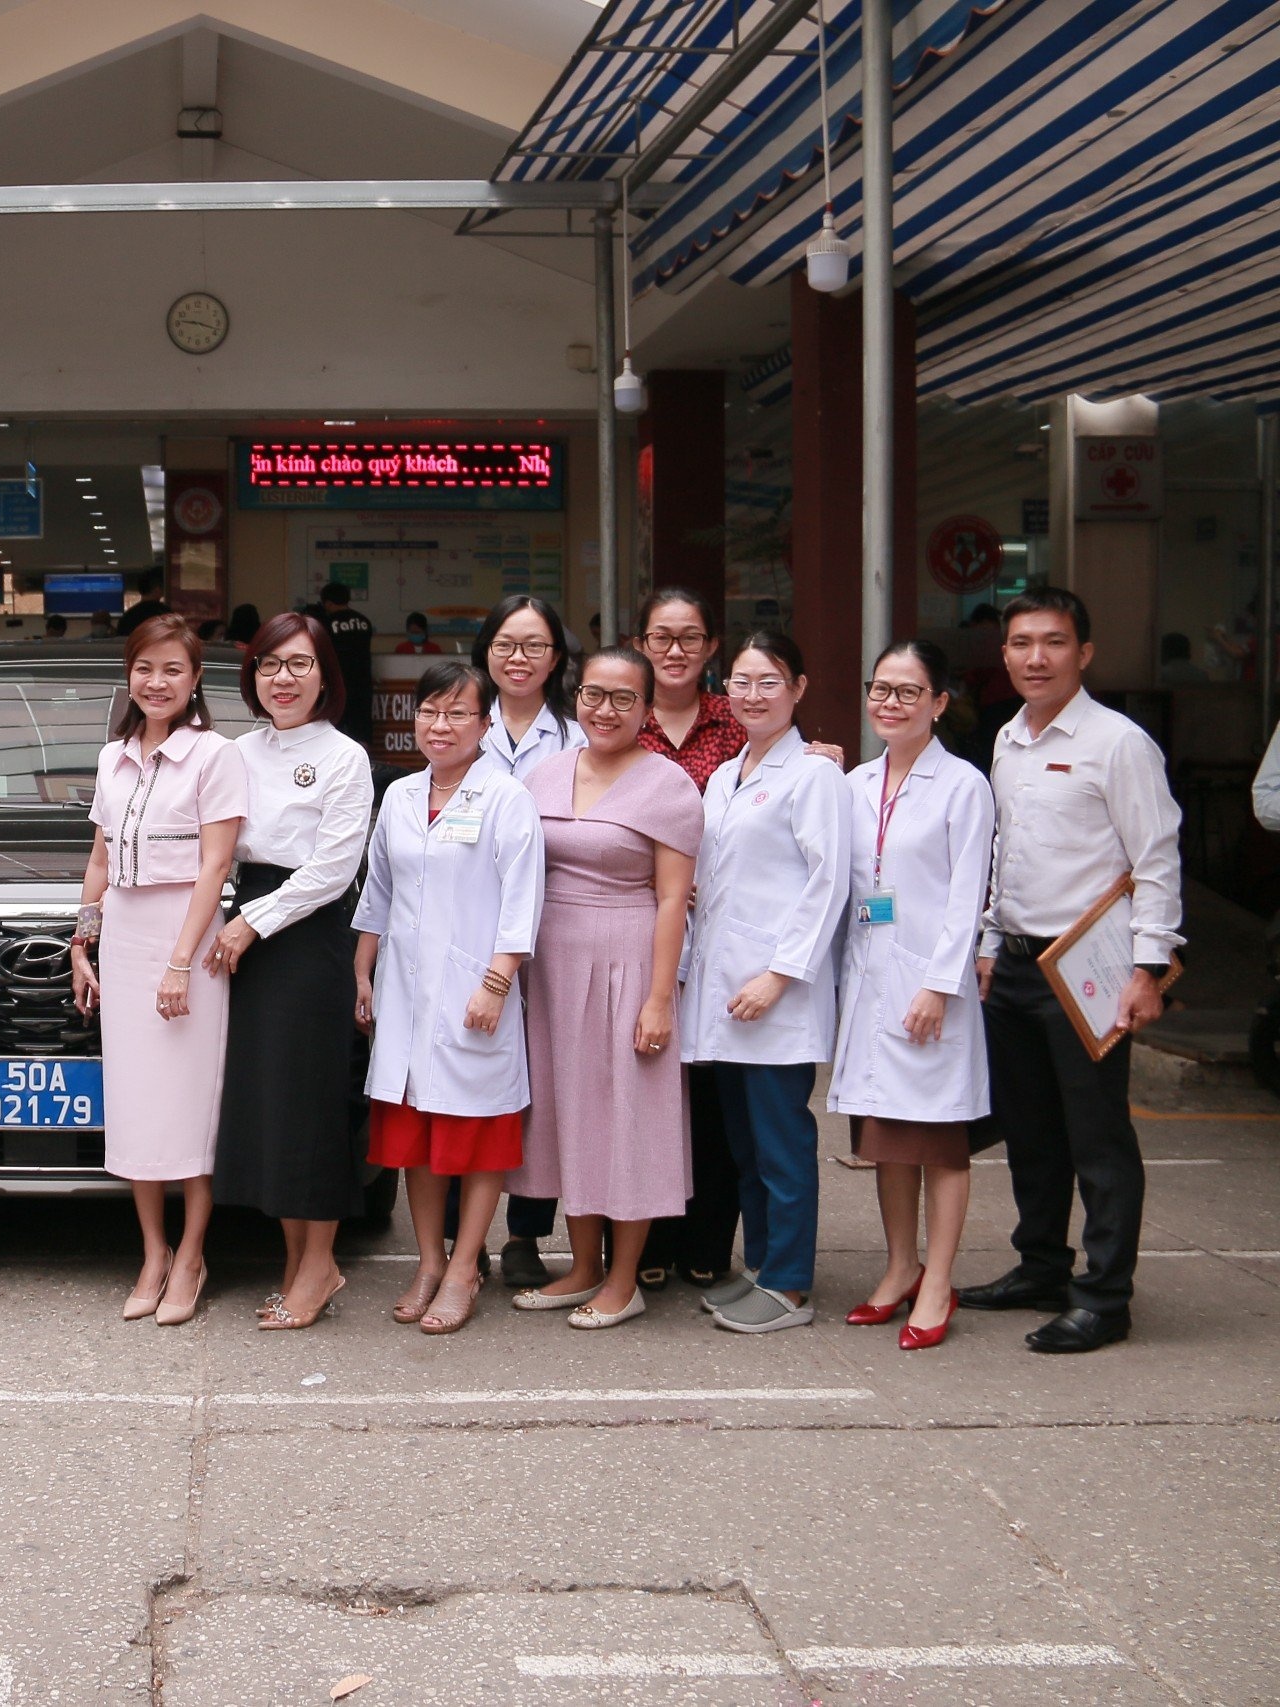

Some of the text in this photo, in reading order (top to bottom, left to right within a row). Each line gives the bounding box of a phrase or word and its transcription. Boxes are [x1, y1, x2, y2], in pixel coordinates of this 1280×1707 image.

[253, 455, 271, 472] in
[276, 454, 316, 472] kính
[320, 454, 362, 472] chào
[368, 454, 401, 477] quý
[405, 454, 458, 473] khách
[7, 1062, 66, 1091] 50A
